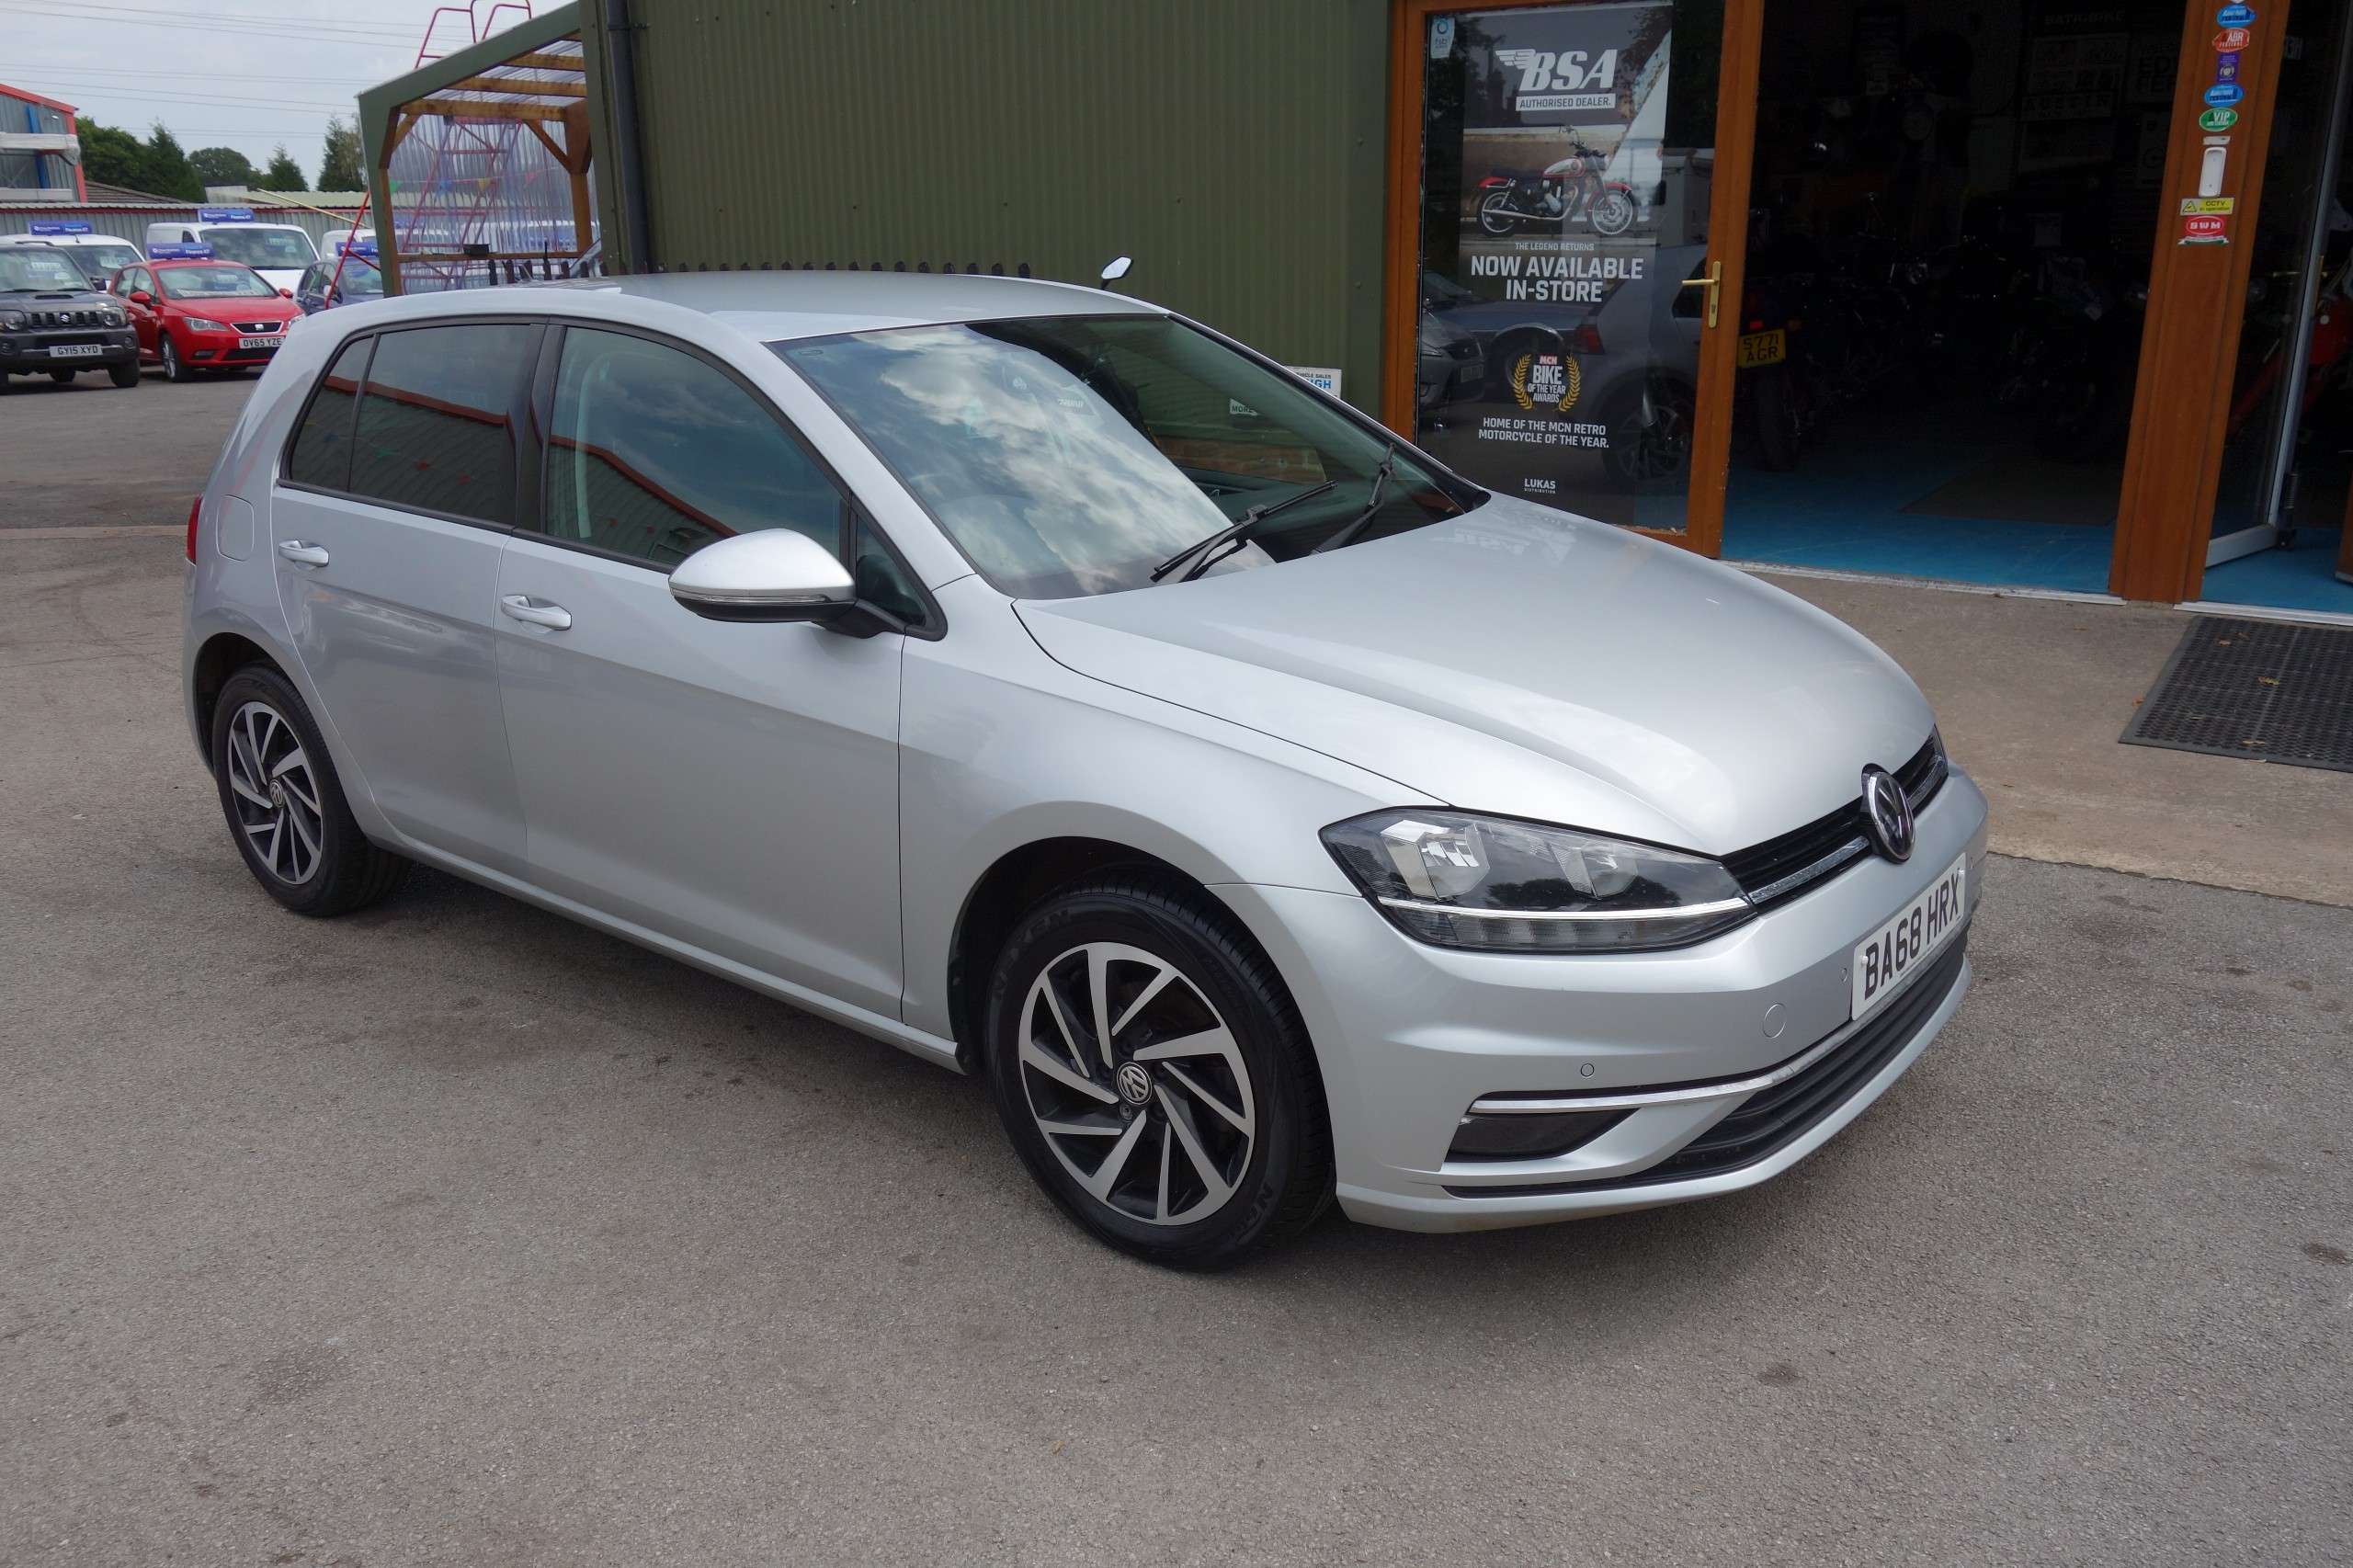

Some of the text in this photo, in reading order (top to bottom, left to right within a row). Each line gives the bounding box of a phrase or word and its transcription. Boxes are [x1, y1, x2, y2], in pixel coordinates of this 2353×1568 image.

[1518, 49, 1618, 91] BSA
[1519, 96, 1610, 108] AUTHORISED DEALER.
[2213, 111, 2231, 121] VIP
[1515, 242, 1595, 251] THE LEGEND RETURNS
[1471, 256, 1644, 279] NOW AVAILABLE
[1506, 279, 1604, 302] IN-STORE
[1539, 355, 1558, 365] MCN
[1532, 365, 1563, 385] BIKE
[1528, 382, 1566, 395] OF THE YEAR
[1532, 392, 1560, 403] AWARDS
[1483, 417, 1607, 435] HOME OF THE MCN RETRO
[1478, 429, 1609, 448] MOTORCYCLE OF THE YEAR.
[1524, 478, 1556, 490] LUKAS
[1864, 867, 1961, 1000] BA68 HRX
